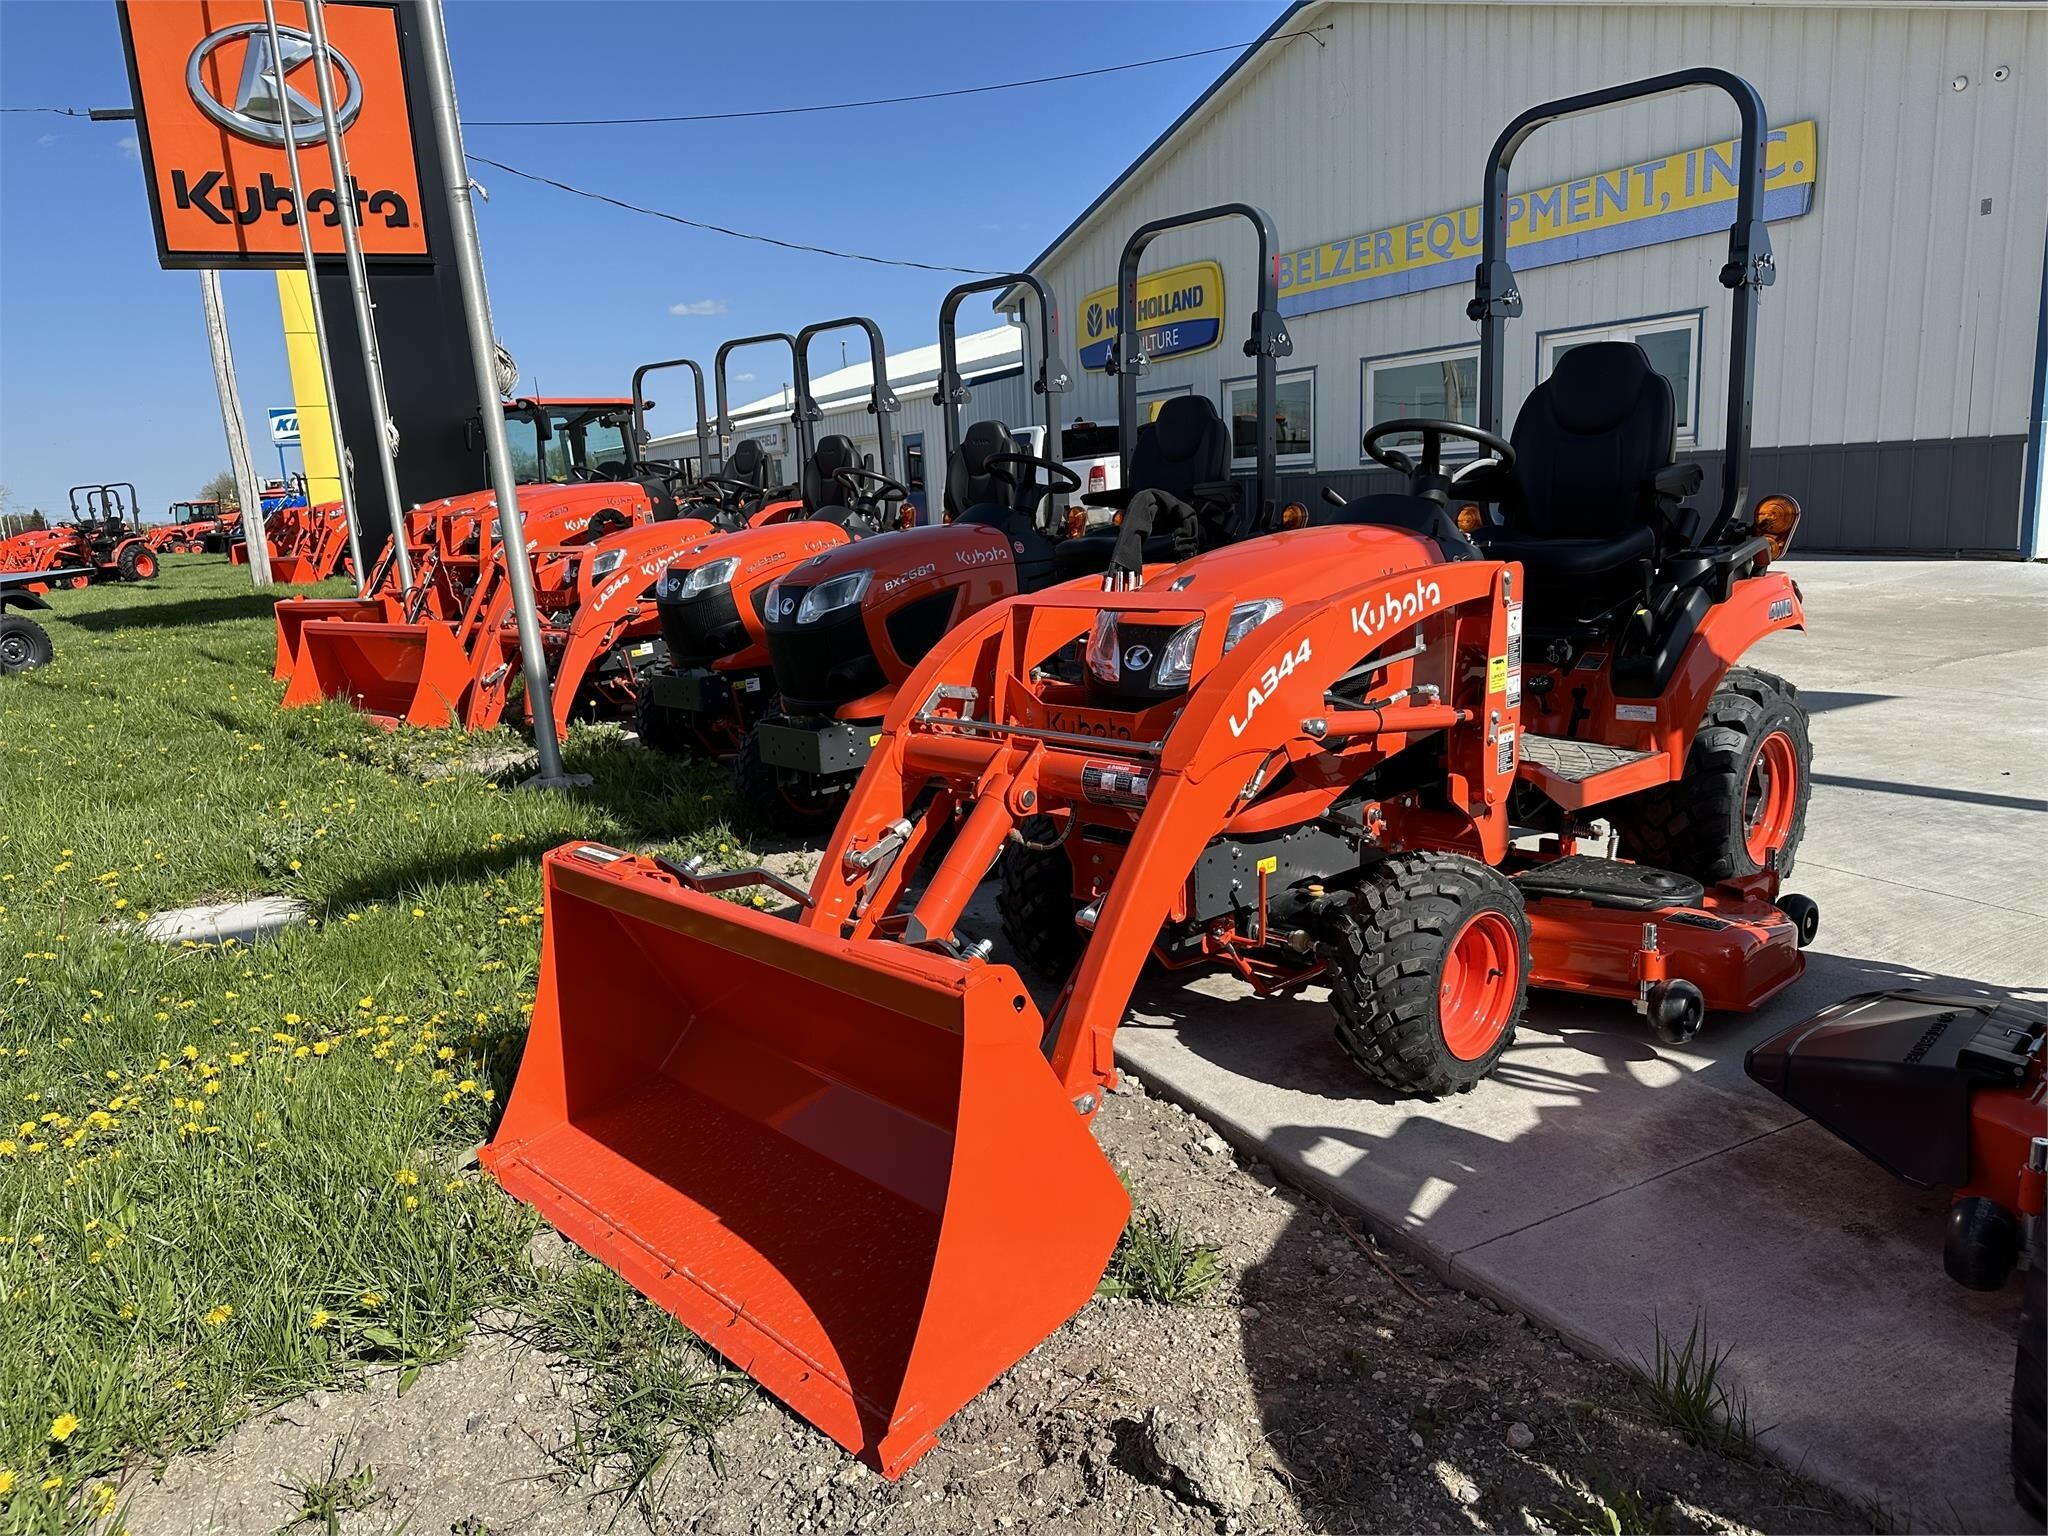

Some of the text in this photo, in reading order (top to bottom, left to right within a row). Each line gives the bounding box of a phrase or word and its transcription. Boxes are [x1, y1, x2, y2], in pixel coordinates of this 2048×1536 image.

[171, 169, 410, 228] Kubota
[1278, 231, 1394, 290] BELZER
[1405, 159, 1670, 261] EQUPMENT,
[1137, 285, 1204, 323] HOLLAND
[955, 546, 1008, 565] Kubota
[593, 574, 630, 612] LA344
[1351, 578, 1440, 636] Kubota
[1228, 637, 1312, 737] LA344
[1046, 710, 1132, 740] Kubota
